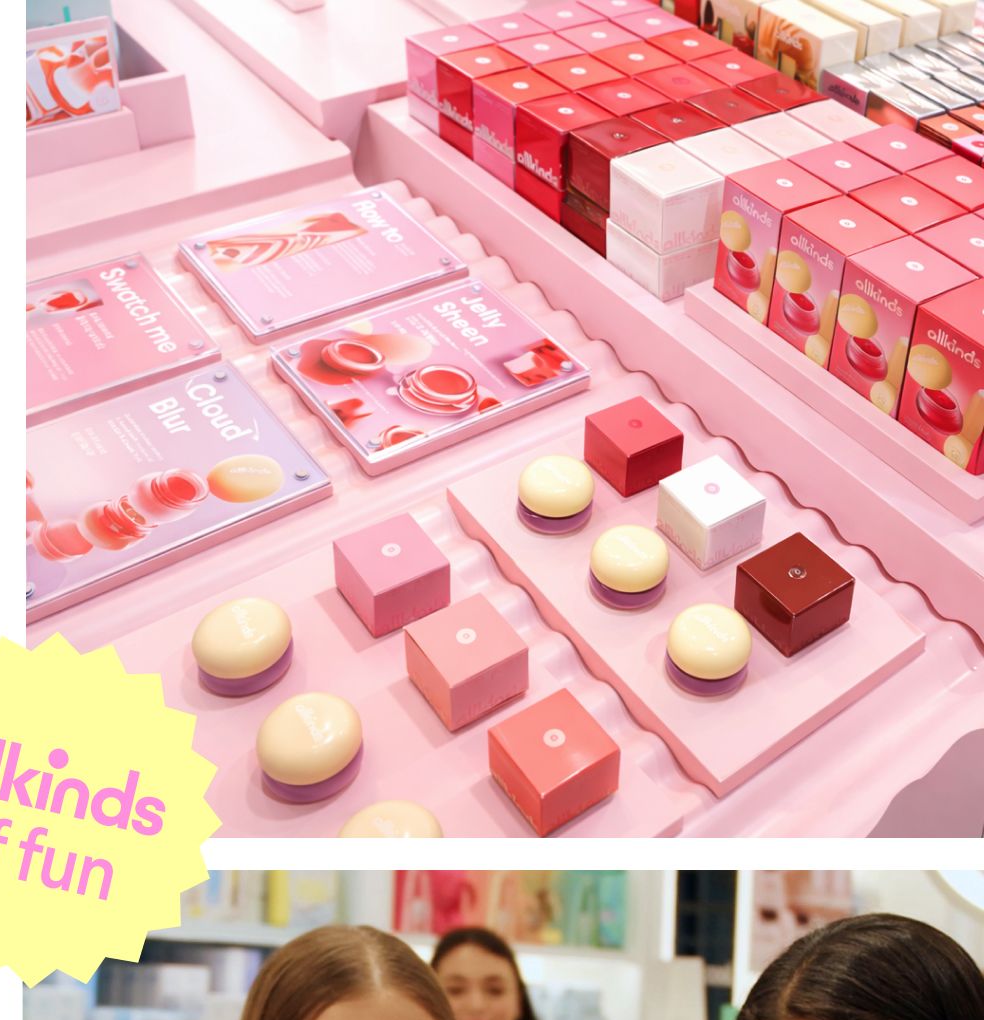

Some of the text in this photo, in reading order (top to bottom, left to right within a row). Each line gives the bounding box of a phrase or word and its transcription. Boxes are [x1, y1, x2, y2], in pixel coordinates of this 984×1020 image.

[517, 150, 559, 186] allkinds
[732, 194, 773, 229] allkinds
[381, 225, 405, 245] to
[790, 234, 835, 272] allkinds
[99, 267, 177, 353] Swatch me
[460, 295, 507, 329] Jelly
[855, 278, 904, 318] allkinds
[432, 301, 489, 347] Sheen
[927, 328, 982, 370] allkinds
[148, 396, 192, 435] Blur
[185, 376, 252, 442] Cloud
